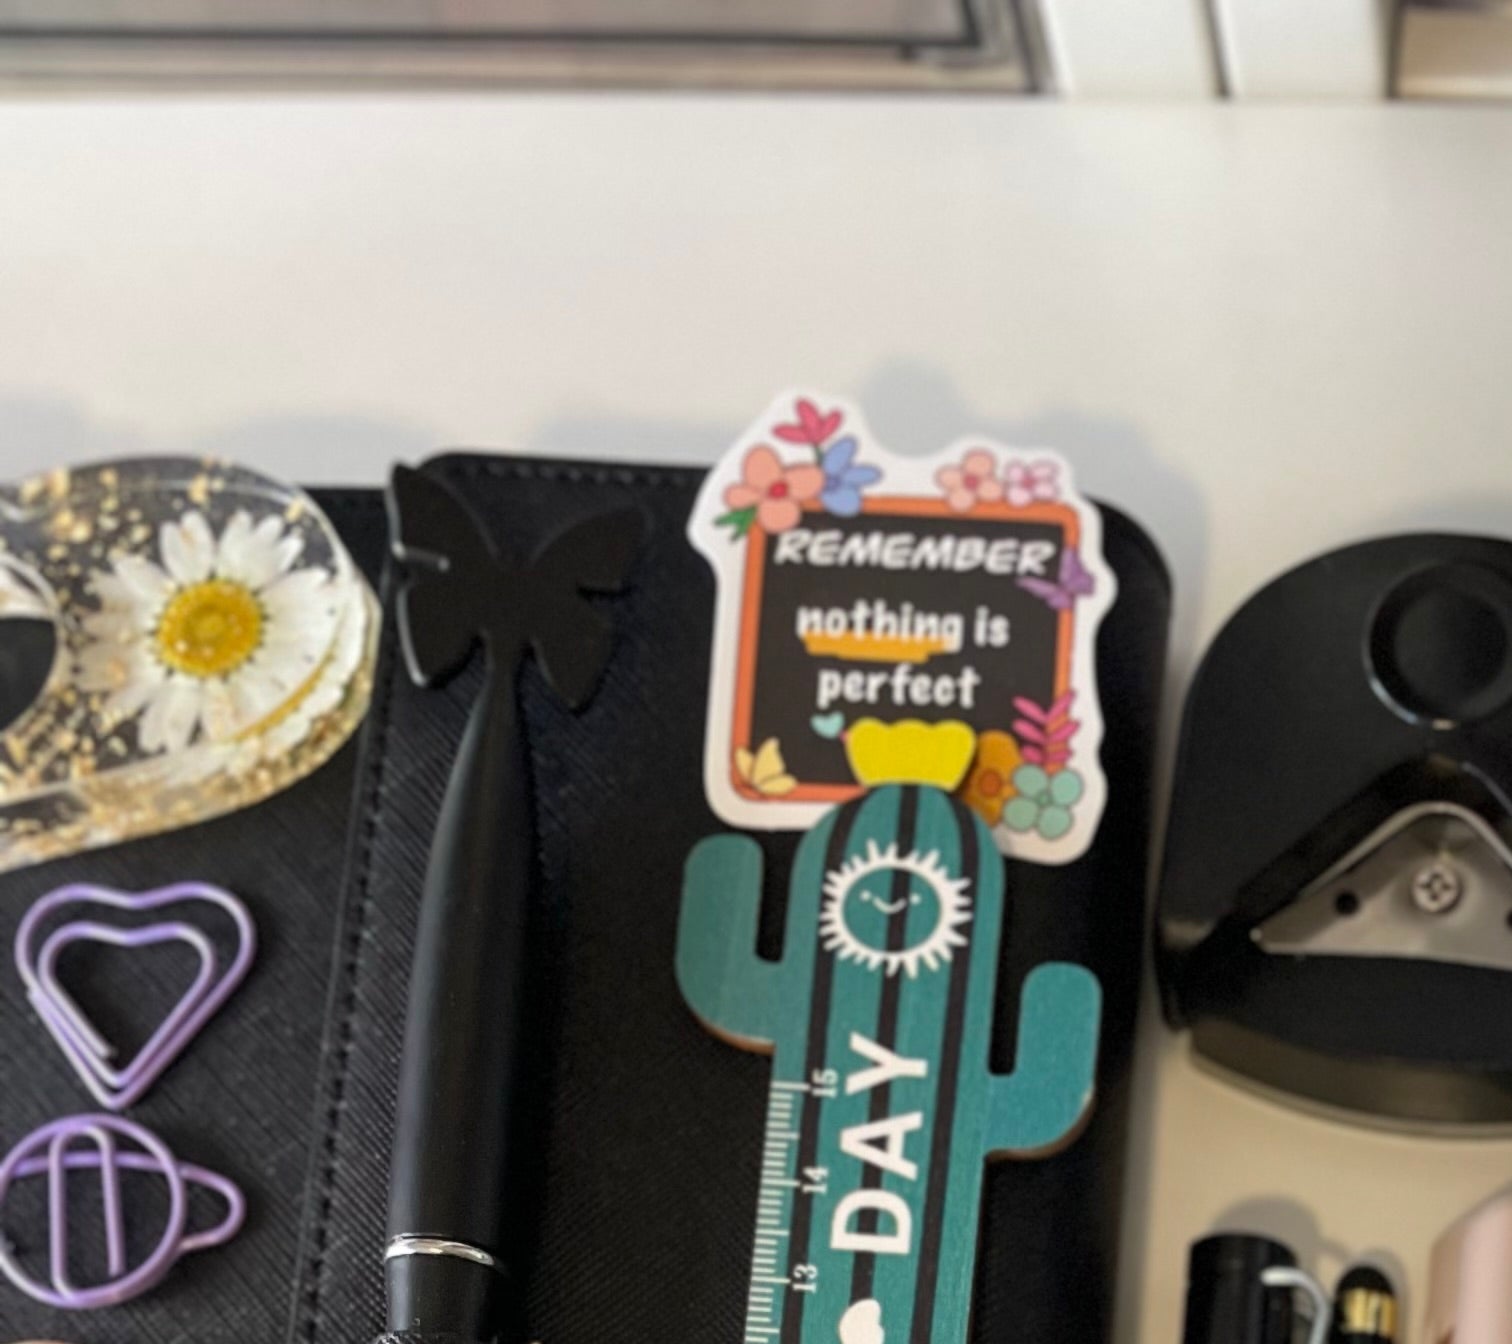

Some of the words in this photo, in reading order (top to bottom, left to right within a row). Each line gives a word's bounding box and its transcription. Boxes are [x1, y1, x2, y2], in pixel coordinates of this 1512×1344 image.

[773, 529, 1056, 575] REMEMBER
[796, 599, 963, 653] nothing
[974, 605, 1010, 648] is
[817, 664, 981, 709] perfect
[811, 1068, 839, 1099] 15
[829, 1031, 928, 1256] DAY
[803, 1166, 829, 1195] 14
[792, 1263, 818, 1293] 13
